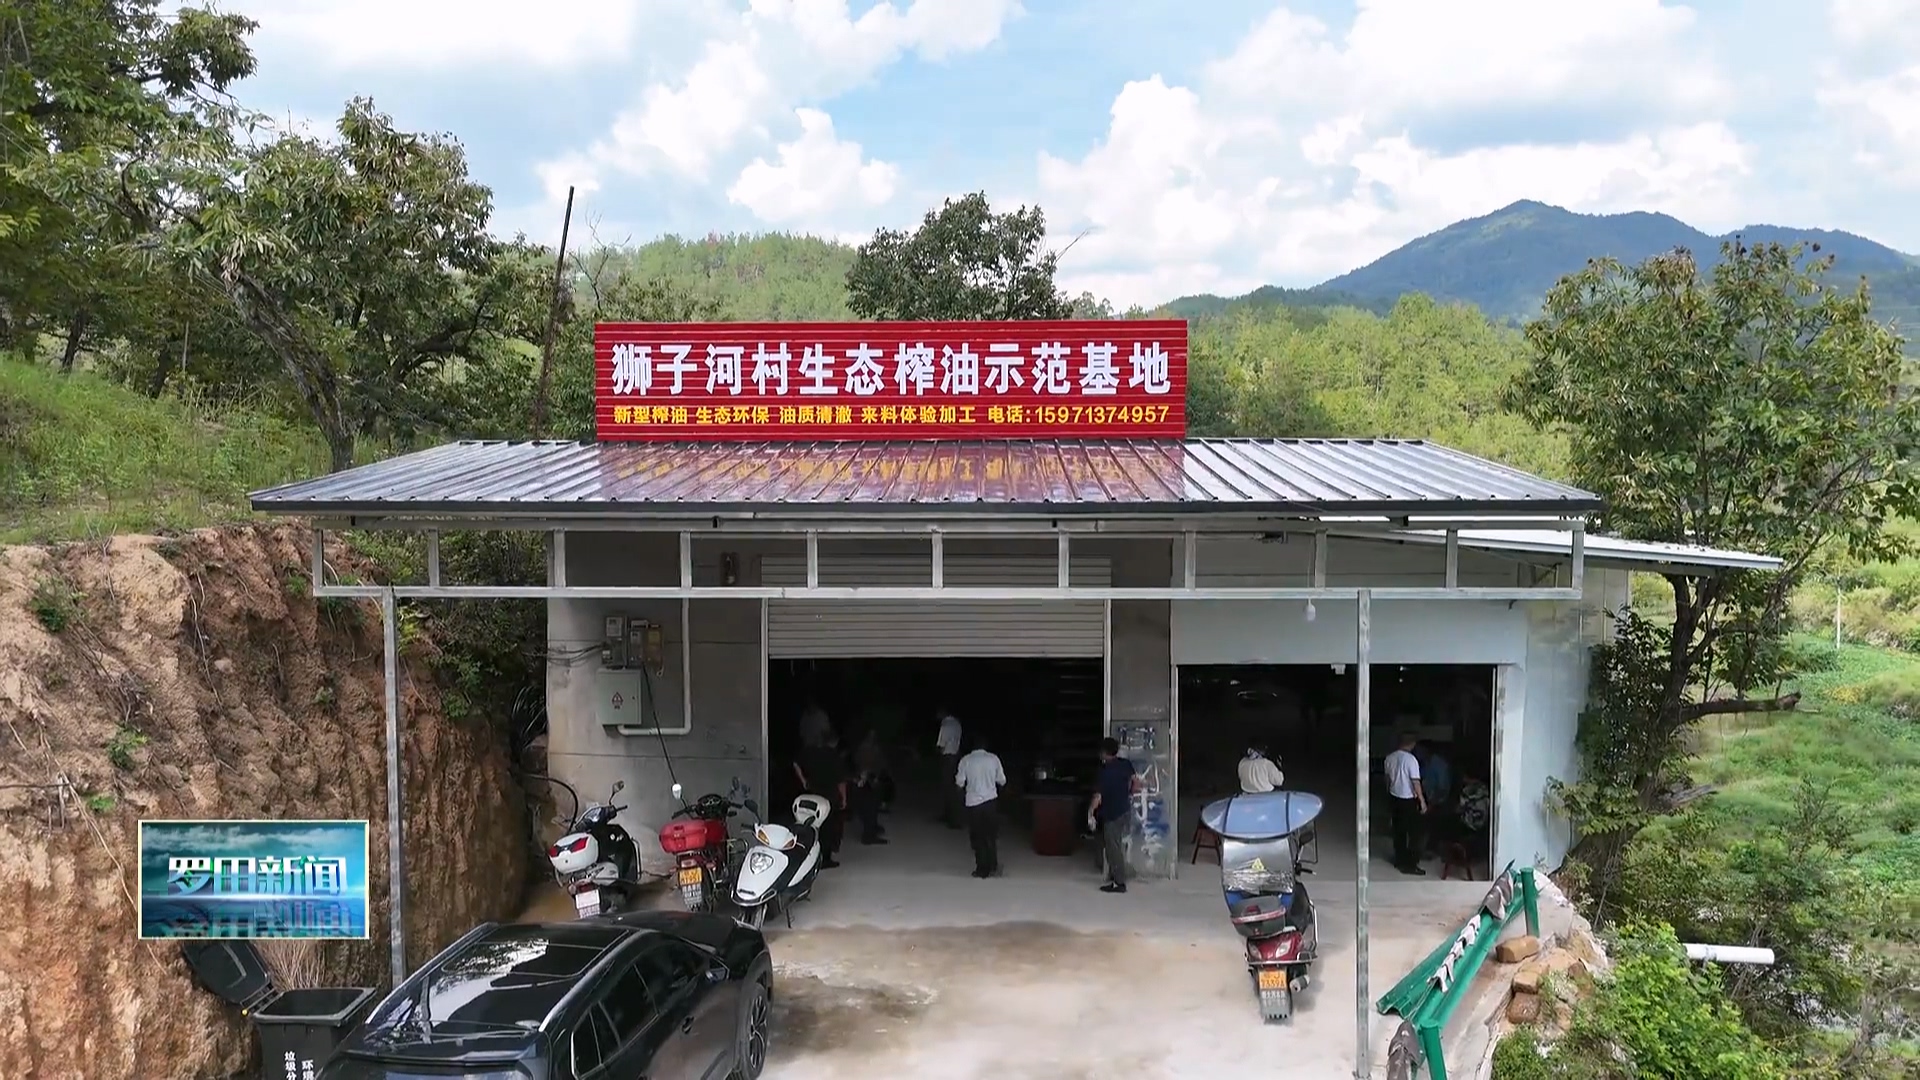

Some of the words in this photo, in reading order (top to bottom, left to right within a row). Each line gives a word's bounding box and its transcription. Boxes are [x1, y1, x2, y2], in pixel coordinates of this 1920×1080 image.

[611, 341, 1171, 396] 狮子河村生态榨油示范基地
[613, 405, 688, 424] 新型榨油
[695, 405, 769, 424] 生态环保
[779, 405, 852, 424] 油质清澈
[861, 405, 976, 424] 来料体验加工
